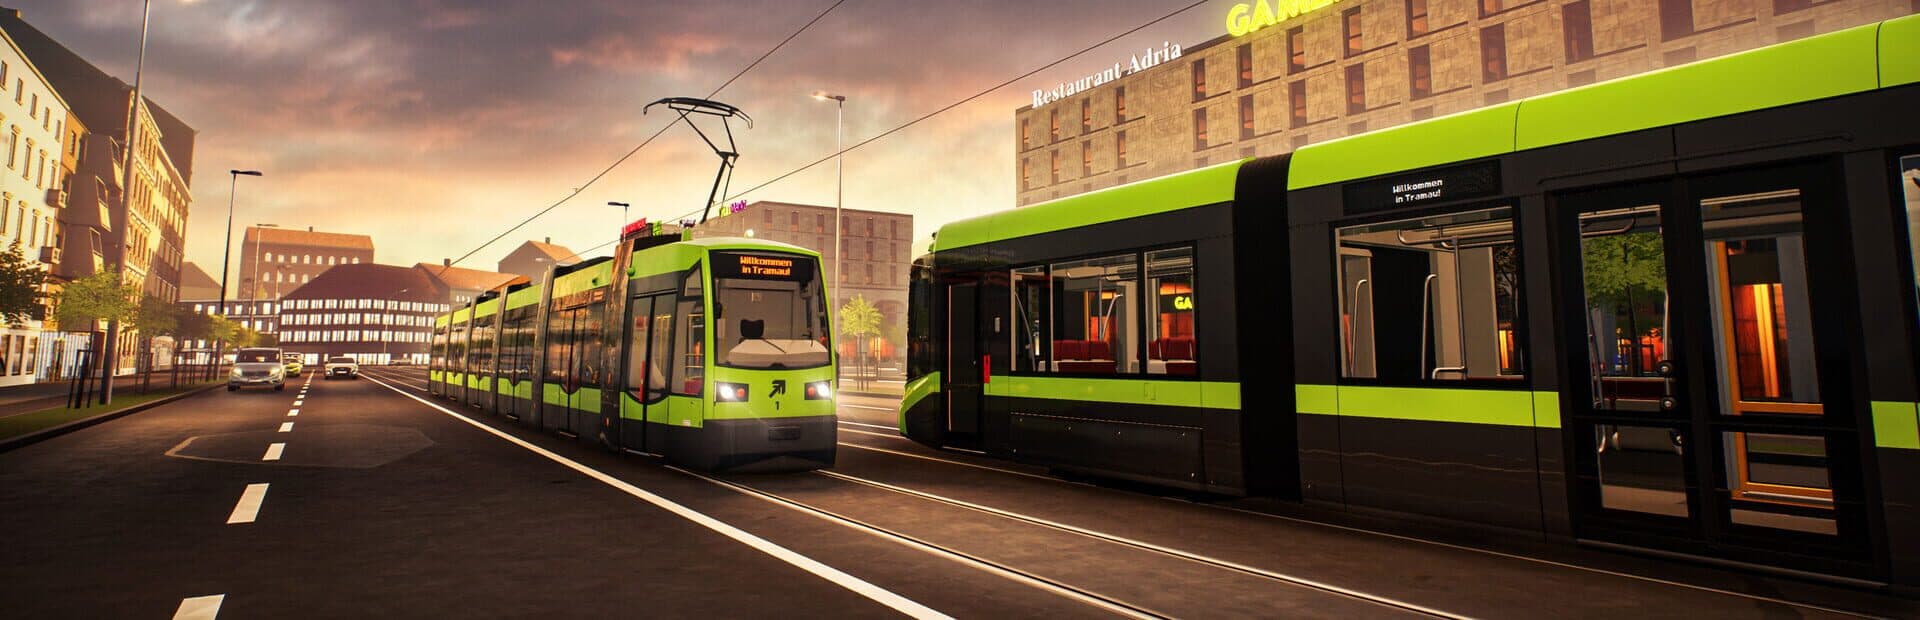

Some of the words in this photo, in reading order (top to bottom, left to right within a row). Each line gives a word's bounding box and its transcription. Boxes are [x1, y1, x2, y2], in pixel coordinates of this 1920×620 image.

[1031, 61, 1122, 109] Restaurant
[1127, 41, 1183, 75] Adria
[1392, 179, 1443, 194] Willkommen
[1395, 195, 1404, 204] in
[1405, 189, 1441, 201] Tramau!
[740, 255, 793, 267] Willkommen
[741, 265, 751, 274] in
[752, 265, 791, 276] Tramau!
[775, 401, 780, 411] 1
